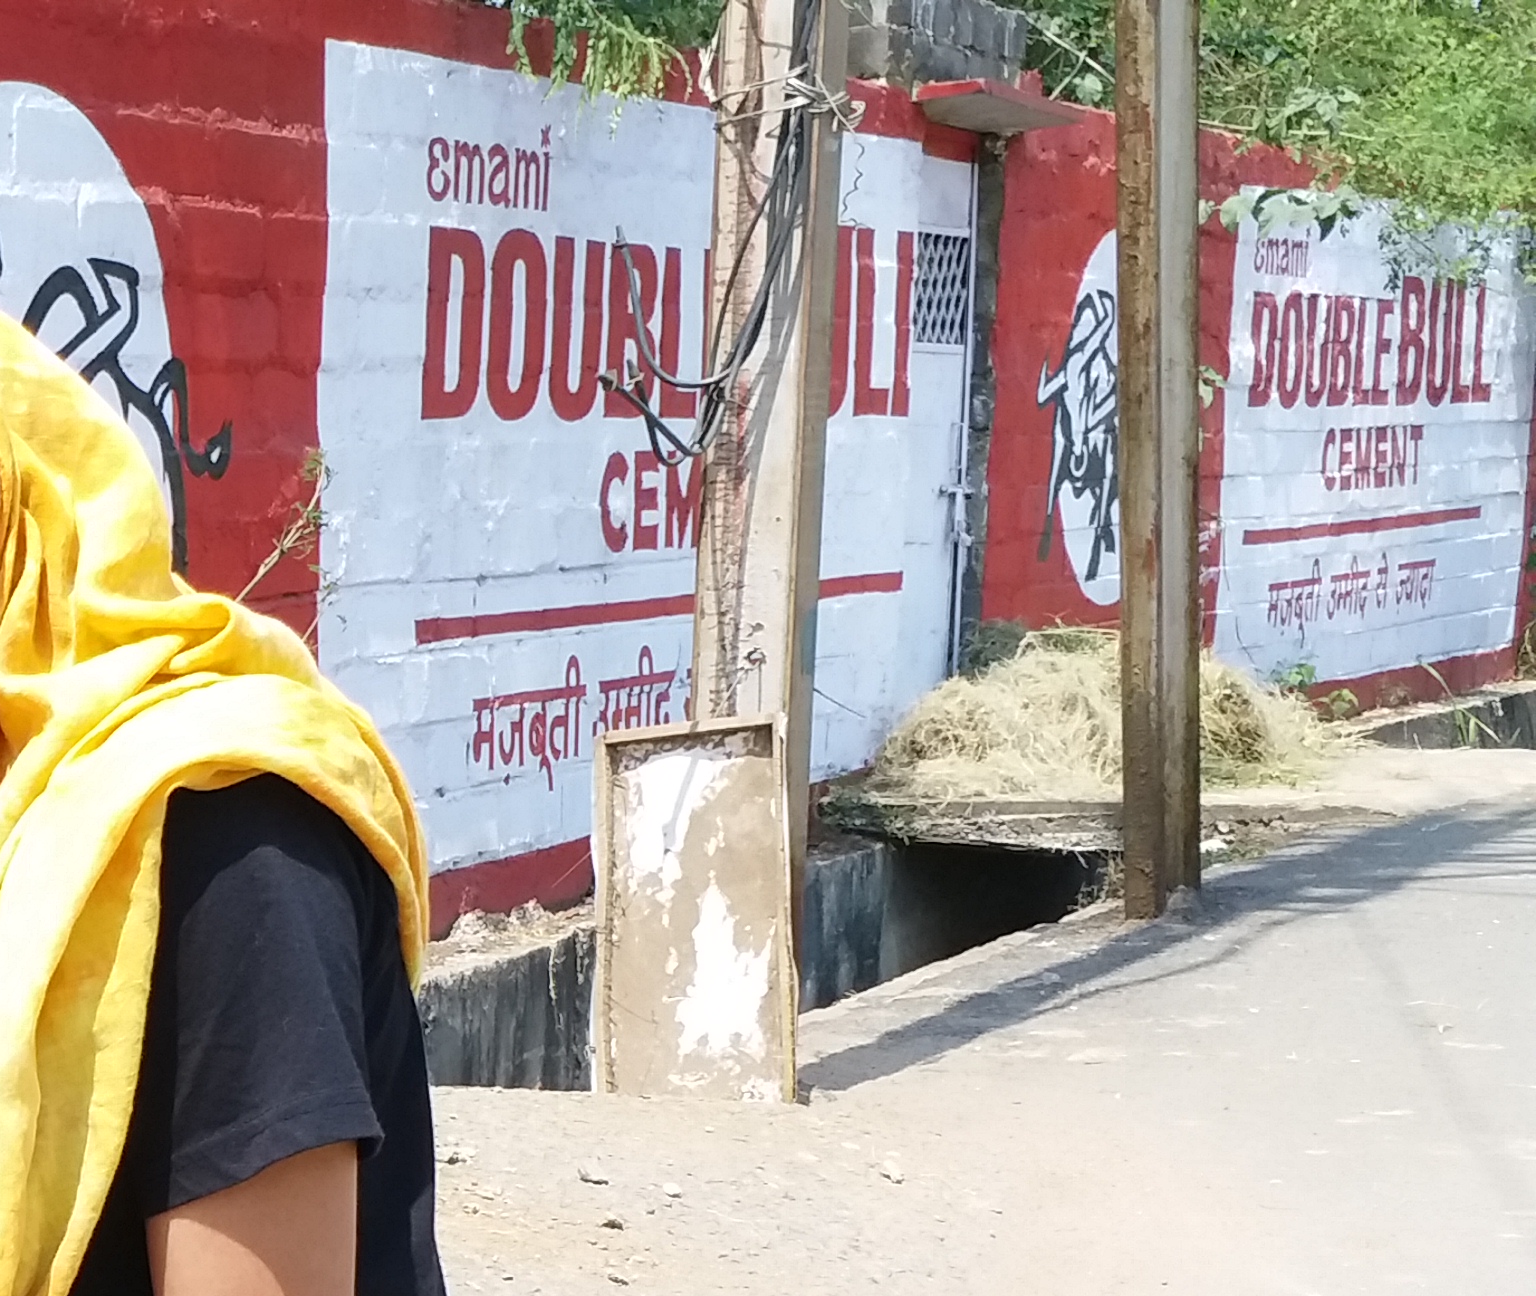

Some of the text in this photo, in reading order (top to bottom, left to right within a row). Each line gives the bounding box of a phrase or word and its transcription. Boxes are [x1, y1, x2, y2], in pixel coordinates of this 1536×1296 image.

[427, 124, 552, 212] emami
[420, 225, 712, 422] DOUBL
[1247, 275, 1492, 409] DOUBLE BULL
[599, 450, 705, 553] CEM
[1321, 424, 1425, 491] CEMENT
